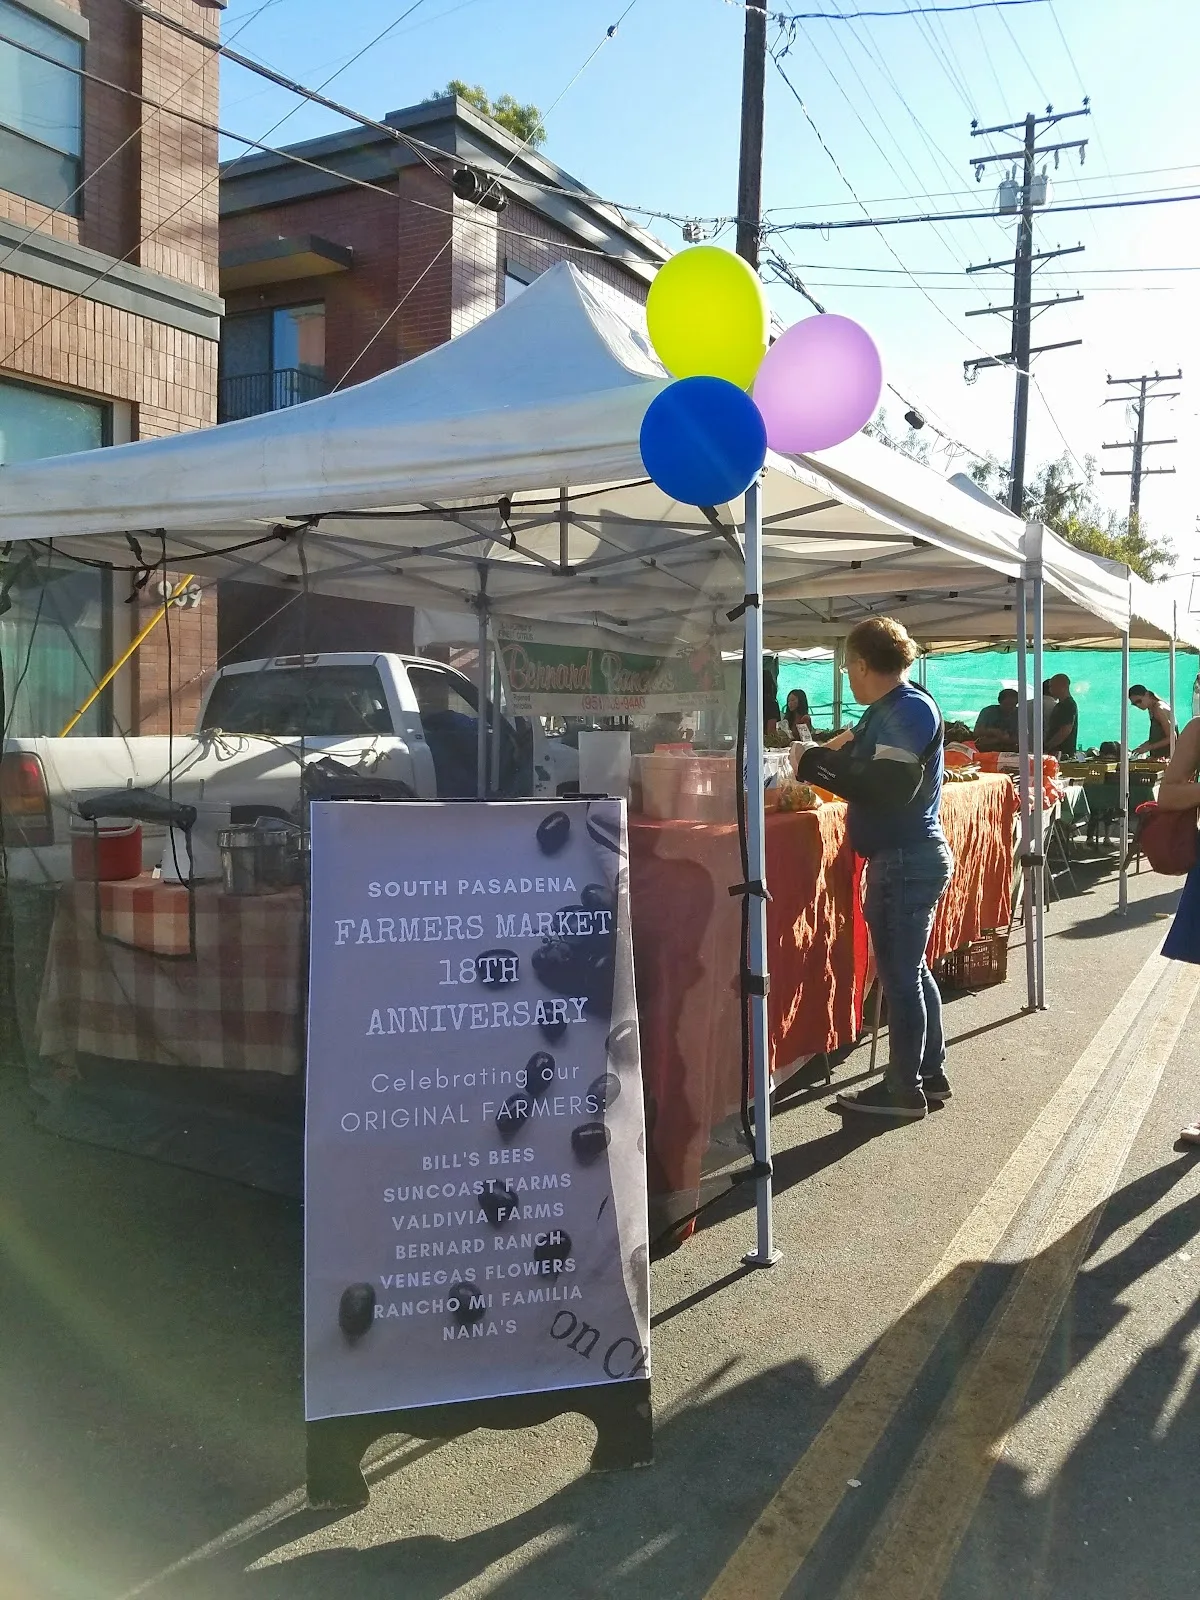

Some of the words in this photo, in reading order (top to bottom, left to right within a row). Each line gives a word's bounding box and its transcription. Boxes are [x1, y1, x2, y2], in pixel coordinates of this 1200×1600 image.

[502, 643, 593, 691] Bernard
[368, 880, 447, 898] SOUTH
[458, 877, 577, 895] PASADENA
[335, 915, 484, 945] FARMERS
[496, 911, 612, 938] MARKET
[439, 957, 520, 985] 18TH
[365, 997, 589, 1035] ANNIVERSARY
[371, 1067, 529, 1093] Celebrating
[541, 1065, 580, 1082] our
[340, 1104, 470, 1132] ORIGINAL
[483, 1094, 608, 1121] FARMERS:
[422, 1152, 480, 1171] BILL'S
[489, 1148, 535, 1165] BEES
[383, 1180, 497, 1203] SUNCOAST
[505, 1173, 572, 1193] FARMS
[392, 1211, 488, 1231] VALDIVIA
[497, 1203, 565, 1222] FARMS
[395, 1239, 485, 1260] BERNARD
[494, 1231, 562, 1252] RANCH
[380, 1267, 477, 1290] VENEGAS
[485, 1258, 577, 1280] FLOWERS
[373, 1298, 460, 1319] RANCHO
[469, 1297, 493, 1310] MI
[502, 1285, 583, 1307] FAMILIA
[443, 1320, 517, 1341] NANA'S
[550, 1310, 600, 1359] on
